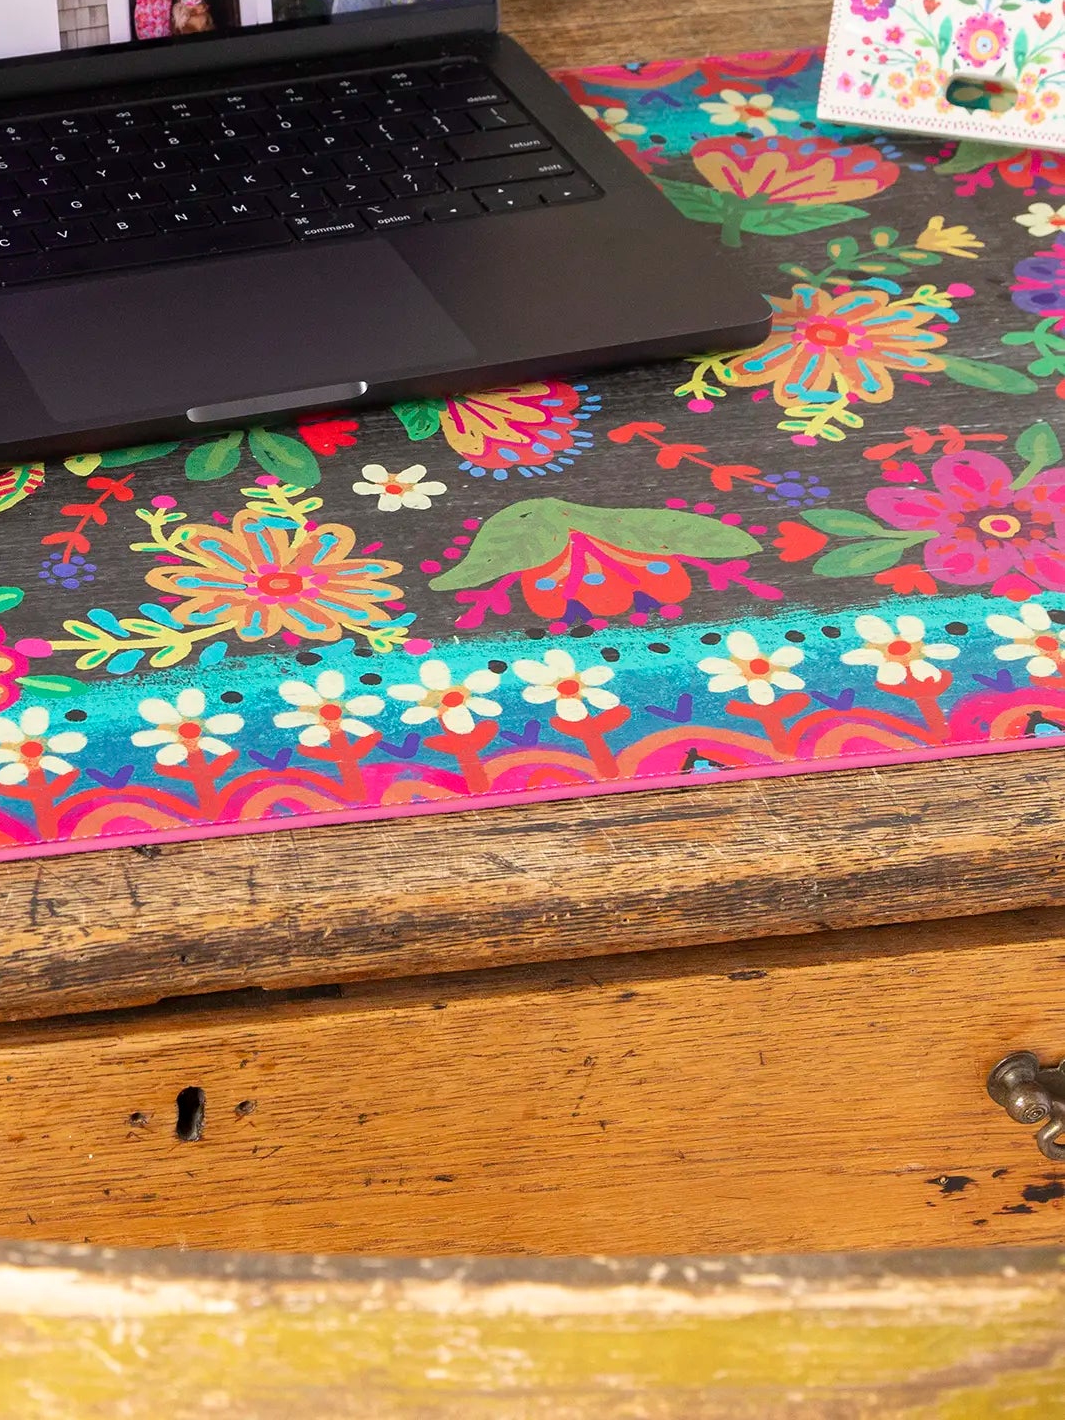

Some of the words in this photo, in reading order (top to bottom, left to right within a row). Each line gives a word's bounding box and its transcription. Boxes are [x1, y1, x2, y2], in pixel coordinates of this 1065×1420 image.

[467, 93, 498, 103] delete
[509, 139, 541, 149] return
[539, 163, 563, 172] shift
[378, 214, 410, 225] option
[305, 222, 354, 235] command
